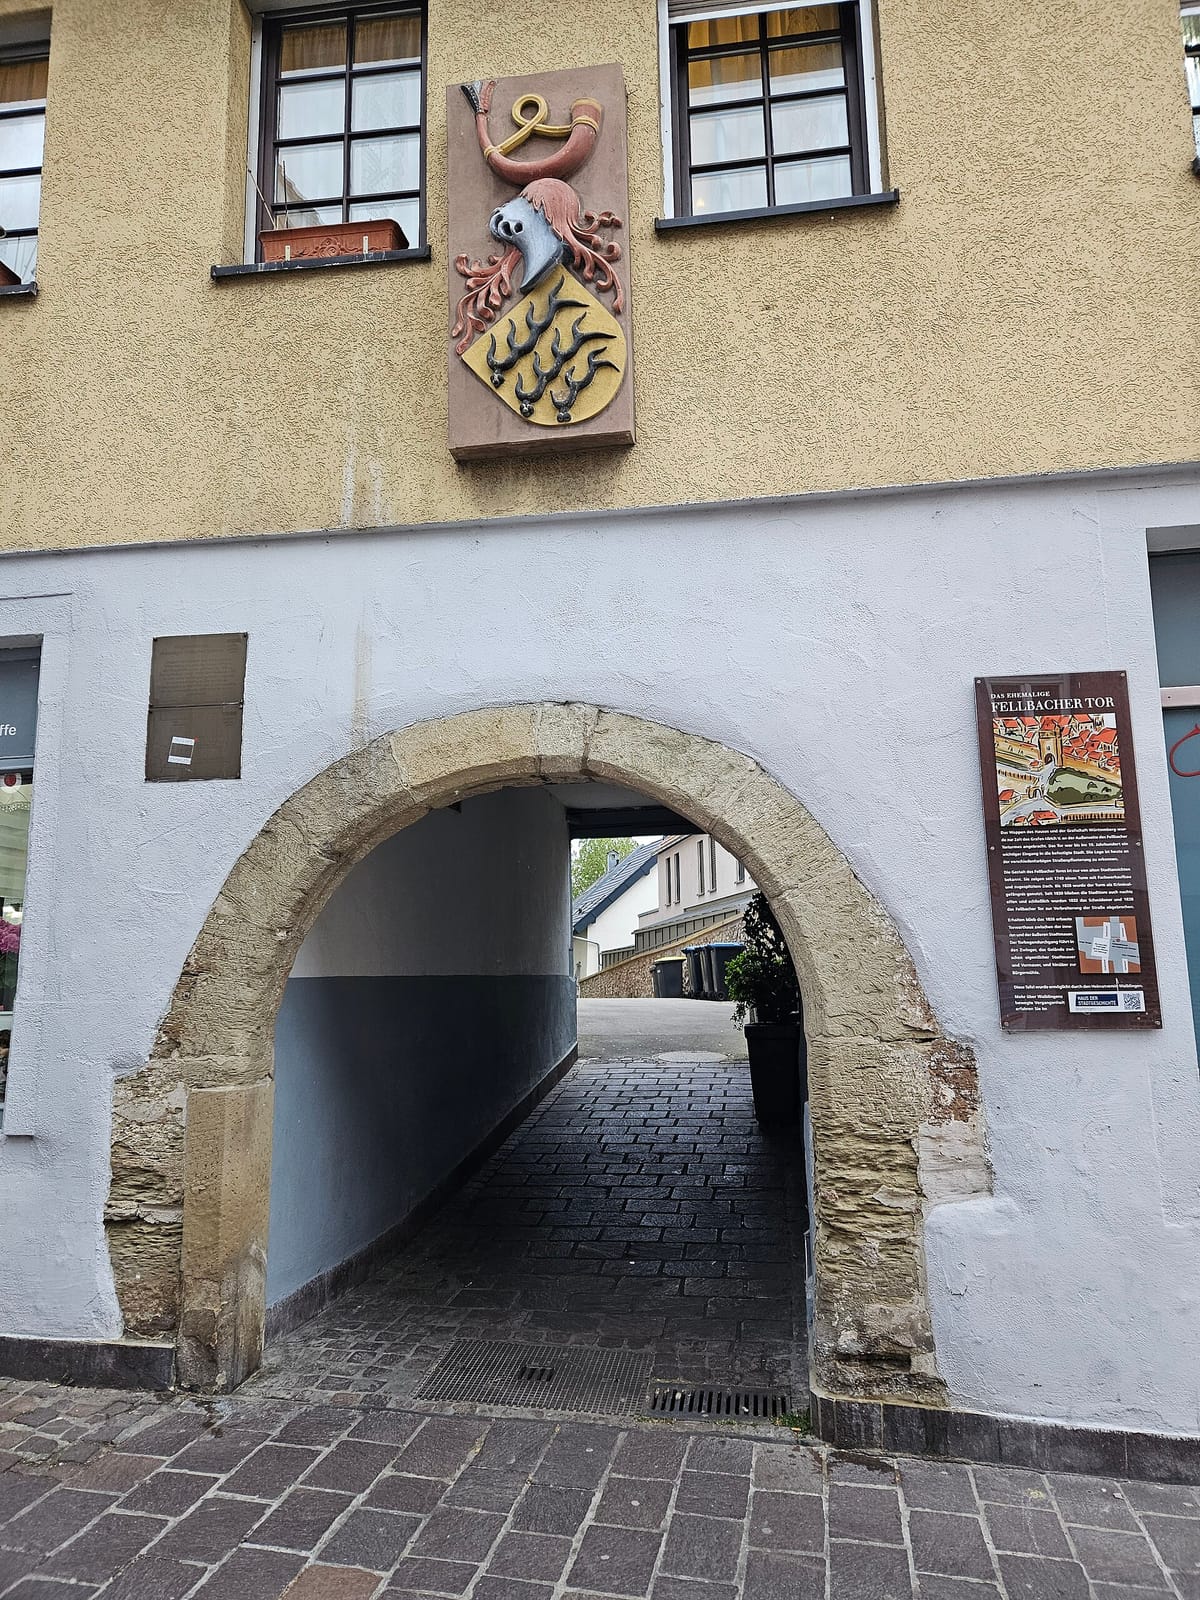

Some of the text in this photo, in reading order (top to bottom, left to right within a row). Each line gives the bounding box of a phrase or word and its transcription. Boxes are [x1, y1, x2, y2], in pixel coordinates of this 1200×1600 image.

[1007, 690, 1051, 698] EHEMALIGE
[991, 696, 1115, 712] FELLBACHER TOR
